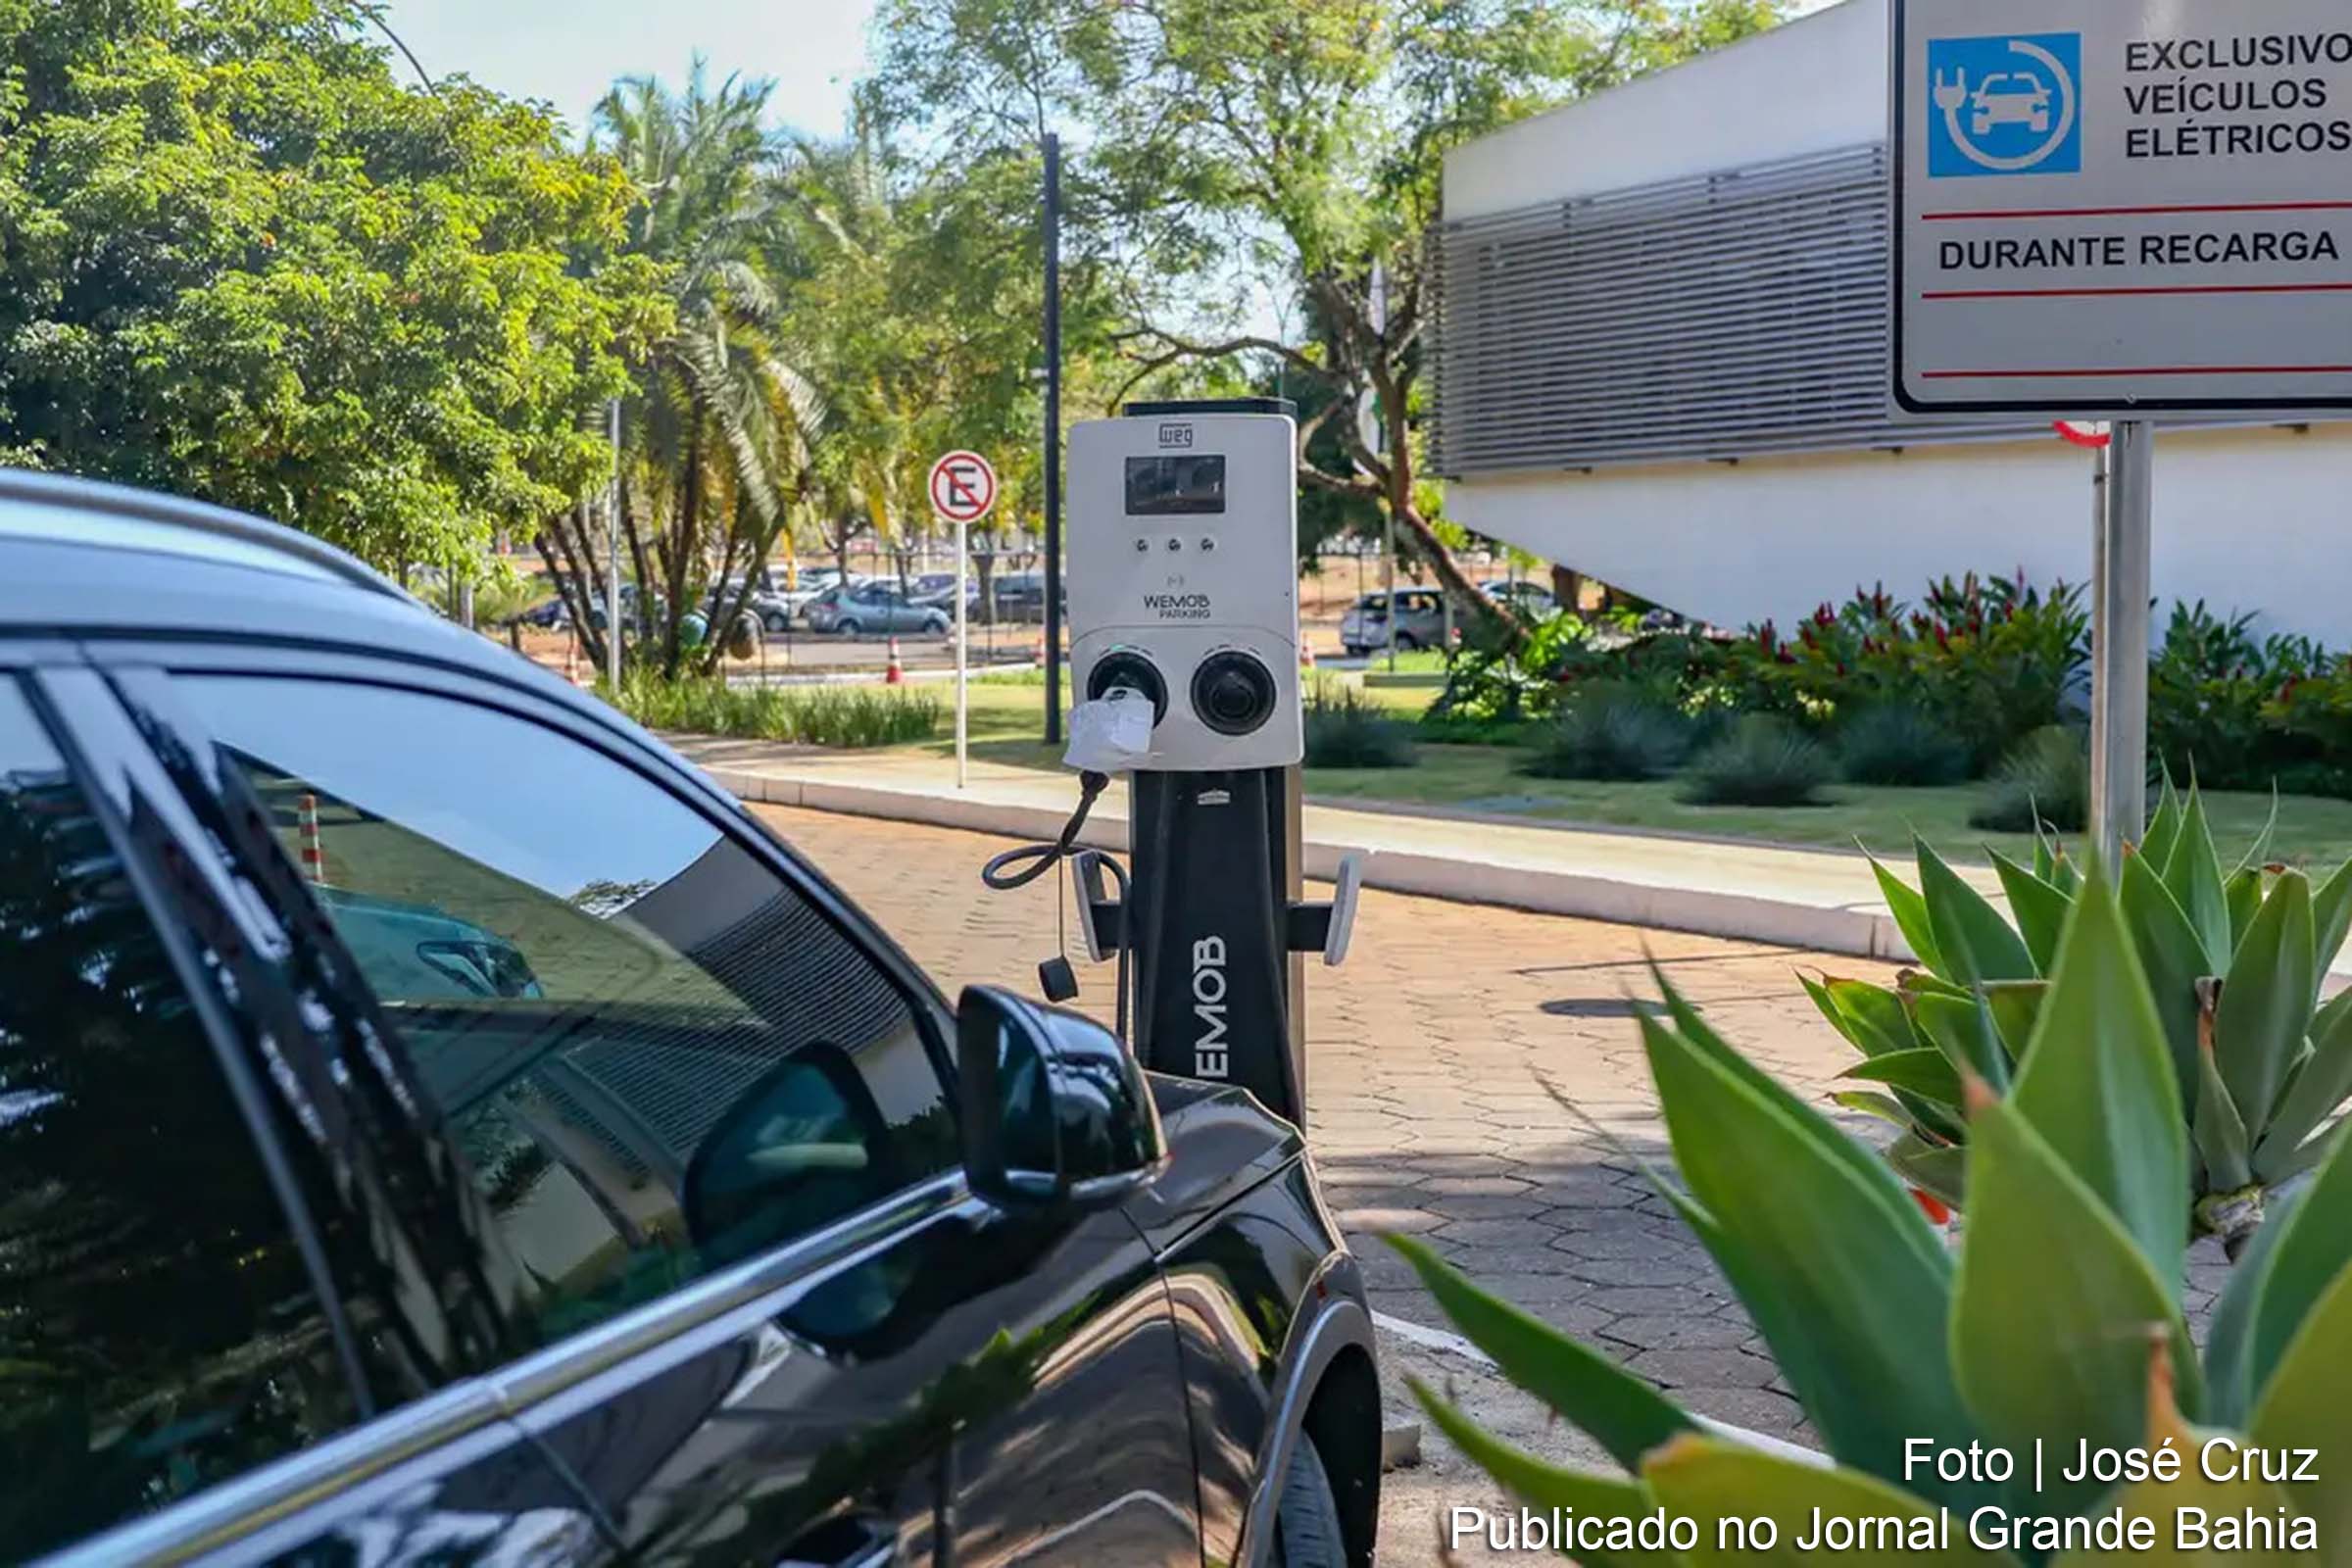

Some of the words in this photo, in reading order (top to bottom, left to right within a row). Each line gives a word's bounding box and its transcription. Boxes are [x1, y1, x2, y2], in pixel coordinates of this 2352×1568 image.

[2126, 32, 2352, 73] EXCLUSIVO
[2124, 76, 2327, 115] VEÍCULOS
[2126, 119, 2351, 158] ELÉTRICOS
[1939, 235, 2125, 270] DURANTE
[2139, 230, 2339, 266] RECARGA
[949, 466, 977, 507] E
[1144, 594, 1210, 609] WEMOB
[1159, 609, 1211, 619] PARKING
[1193, 935, 1229, 1078] EMOB
